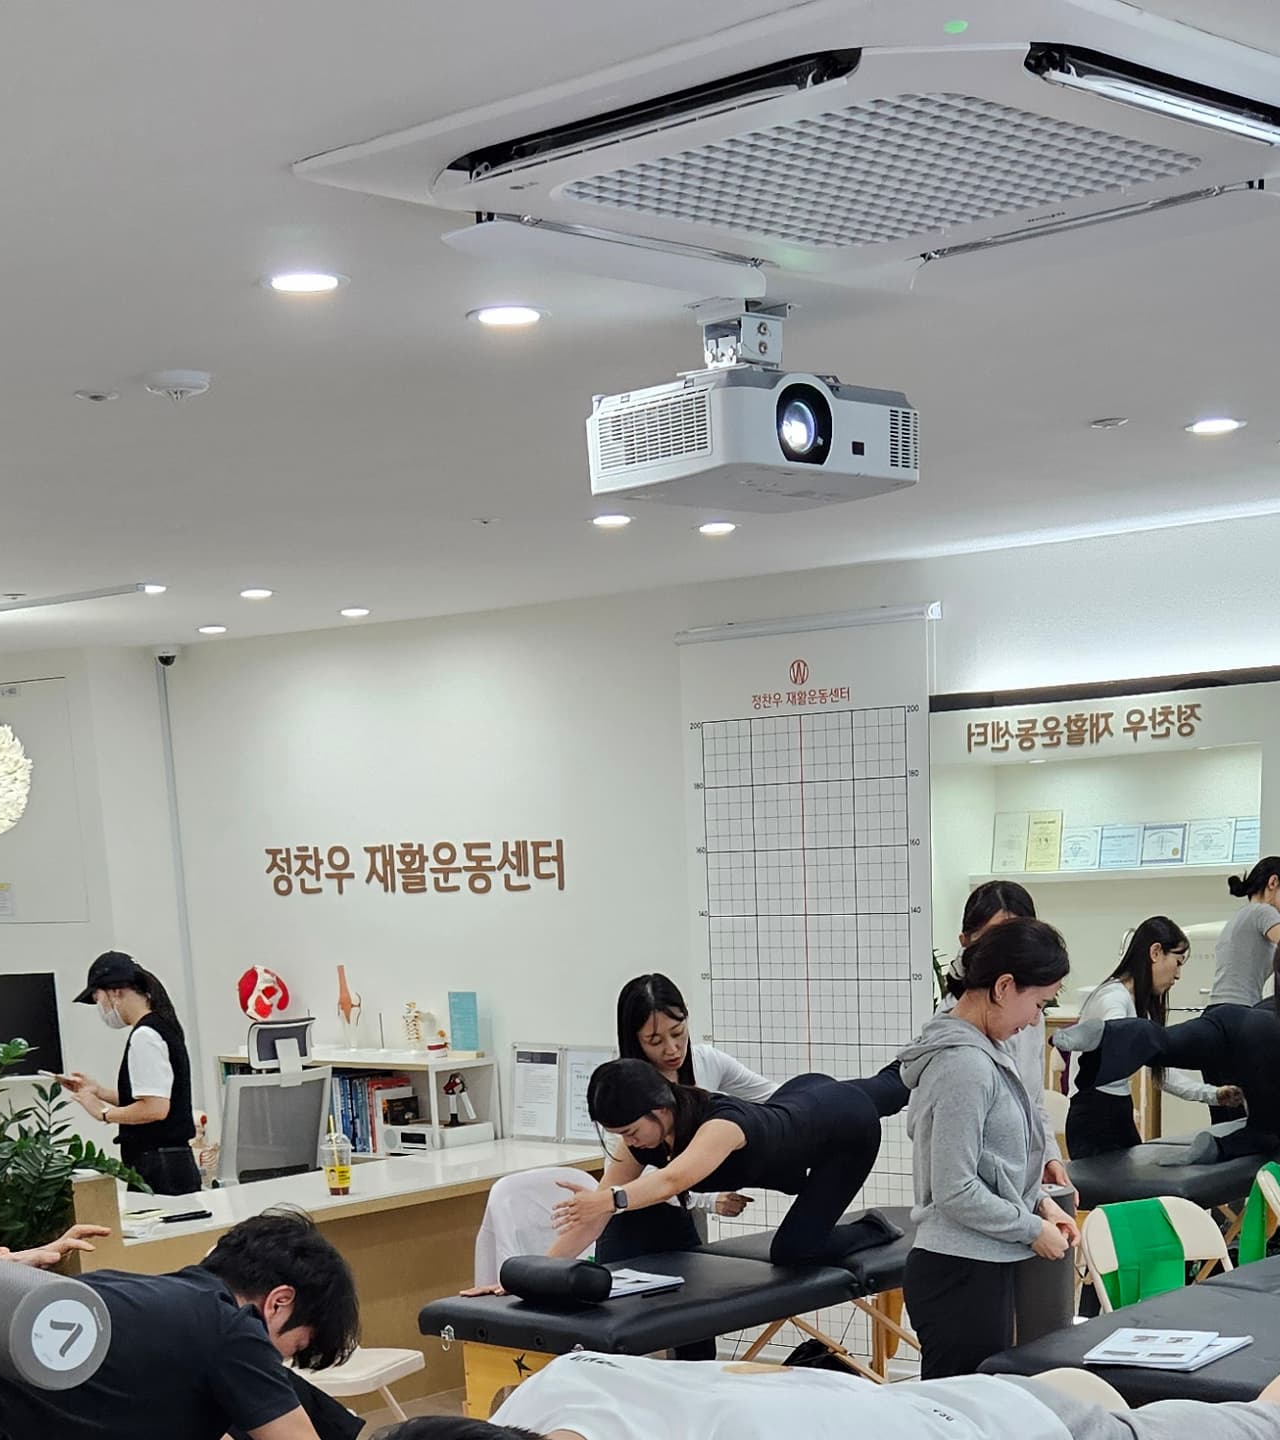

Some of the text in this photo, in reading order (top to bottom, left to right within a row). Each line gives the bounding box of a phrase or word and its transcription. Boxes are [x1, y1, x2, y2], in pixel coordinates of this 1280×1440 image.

[751, 686, 851, 710] 정찬우 재활운동센터
[906, 704, 920, 713] 200
[689, 722, 702, 730] 200
[909, 838, 921, 847] 160
[264, 838, 566, 897] 정찬우 재활운동센터
[910, 905, 922, 914] 140
[911, 973, 923, 981] 120
